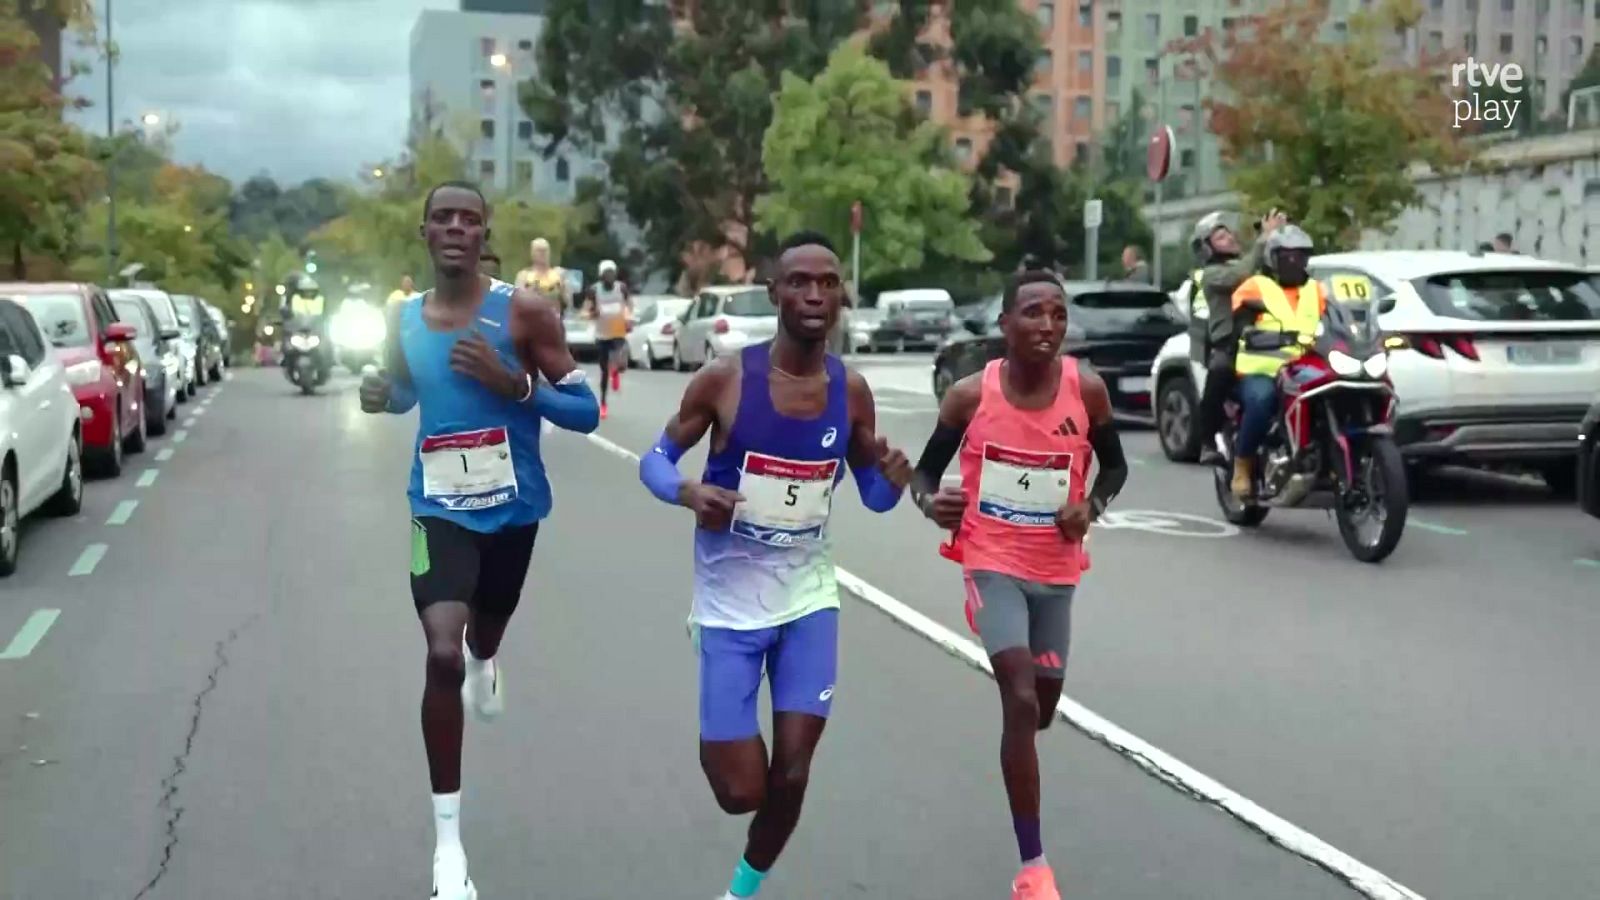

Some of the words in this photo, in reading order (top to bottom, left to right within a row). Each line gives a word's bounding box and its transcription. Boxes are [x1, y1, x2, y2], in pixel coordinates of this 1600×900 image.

[1341, 282, 1366, 298] 10
[460, 454, 468, 473] 1
[1017, 473, 1030, 490] 4
[784, 484, 800, 506] 5
